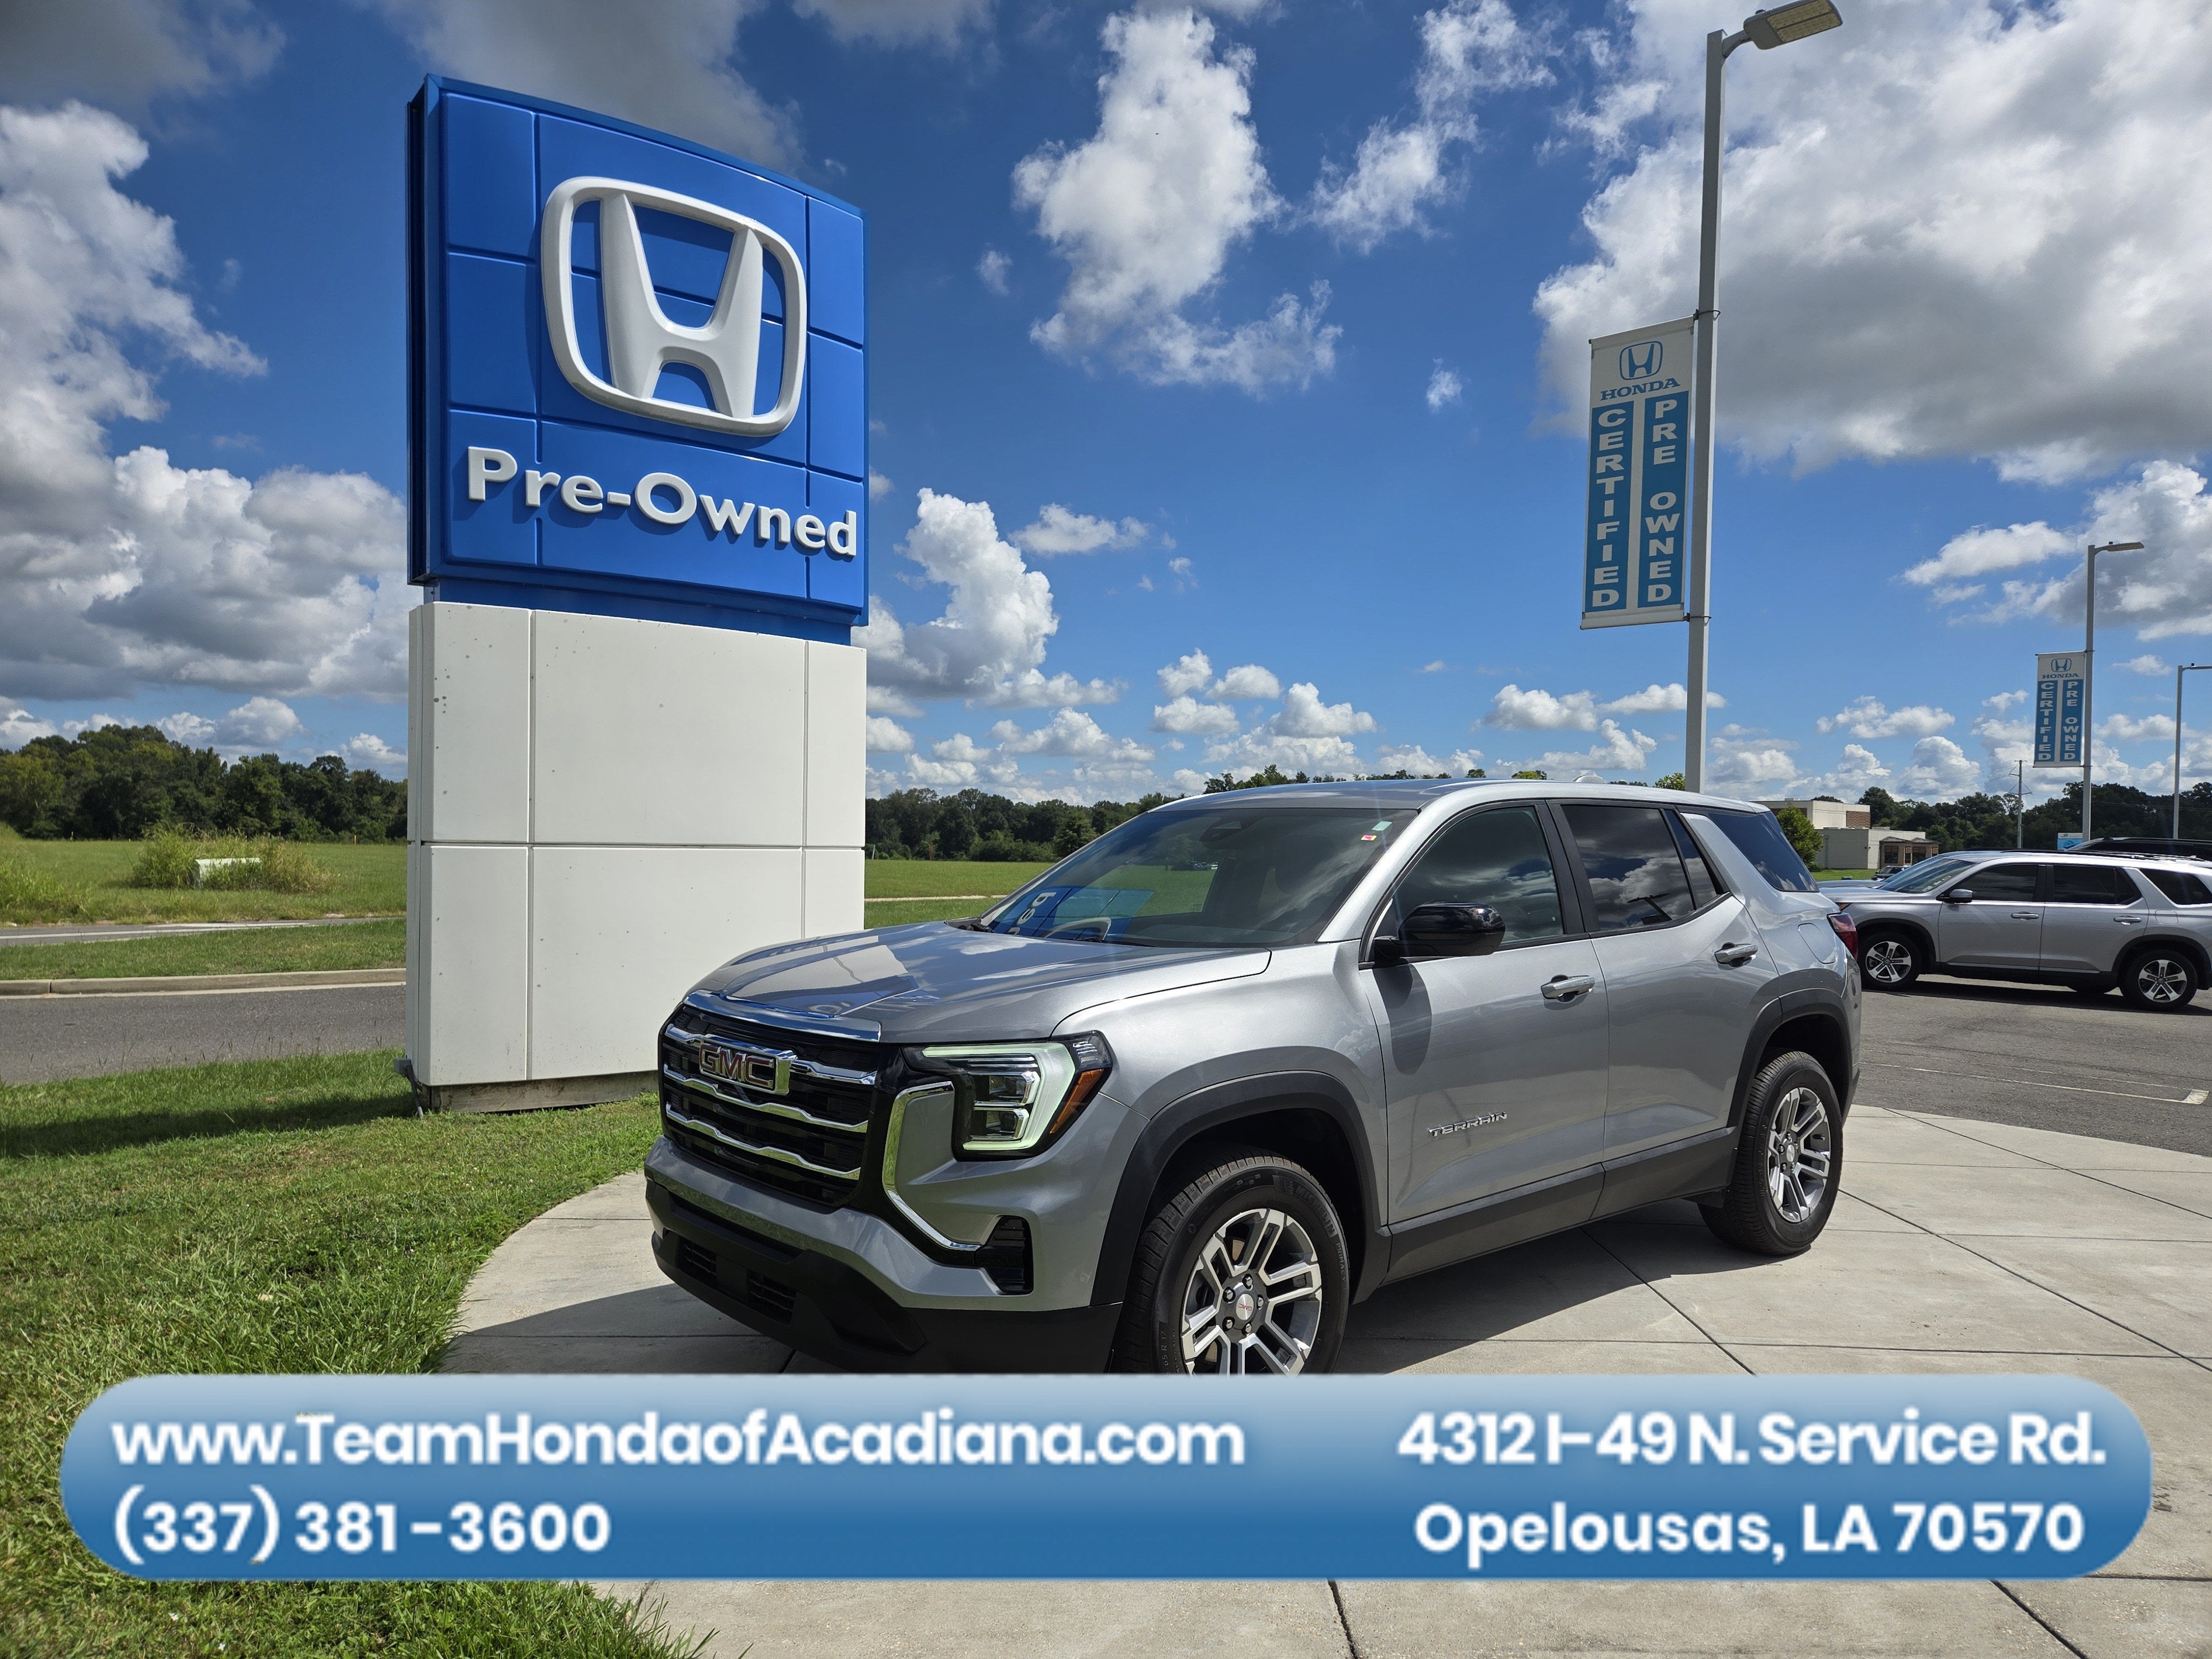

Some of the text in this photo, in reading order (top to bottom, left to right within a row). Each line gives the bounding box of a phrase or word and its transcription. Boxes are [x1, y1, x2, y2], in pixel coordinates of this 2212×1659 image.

[1600, 377, 1681, 400] HONDA
[467, 446, 857, 557] Pre-Owned
[1592, 408, 1627, 607] CERTIFIED
[1645, 399, 1679, 602] PRE OWNED
[2038, 682, 2054, 760] CERTIFIED
[2063, 682, 2079, 760] PRE OWNED
[699, 1043, 774, 1089] GMC
[1428, 1111, 1507, 1136] TERRAIN
